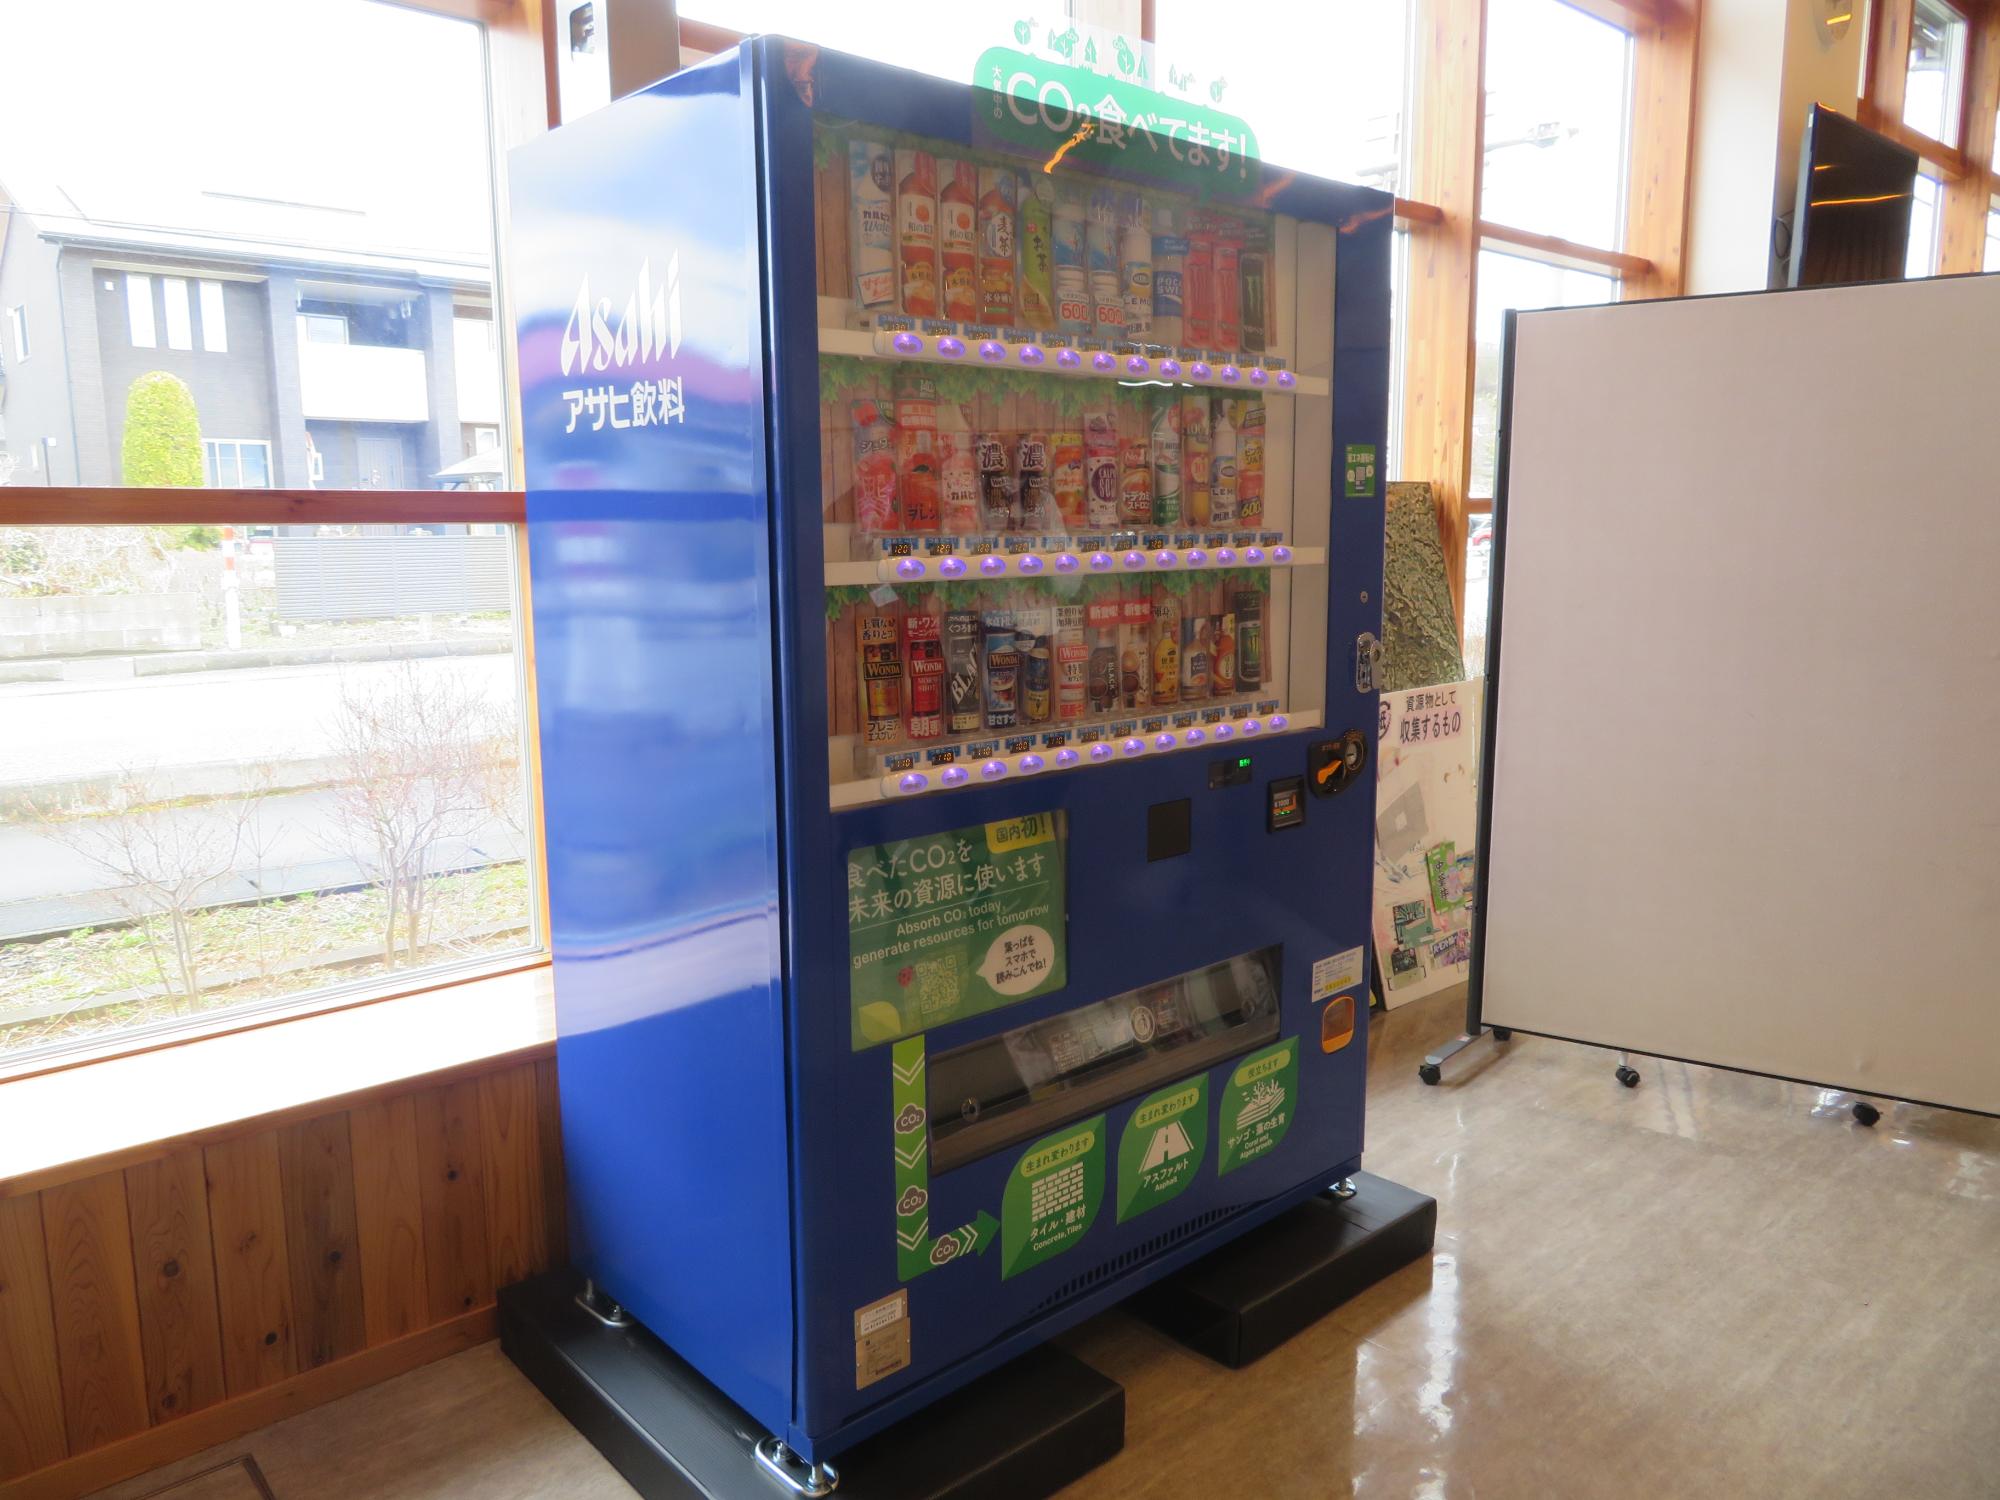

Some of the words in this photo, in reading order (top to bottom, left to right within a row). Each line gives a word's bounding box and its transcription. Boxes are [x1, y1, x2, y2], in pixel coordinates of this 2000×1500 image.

[561, 248, 682, 376] Asahi
[1062, 303, 1088, 320] 600
[1099, 308, 1124, 325] 600
[562, 376, 685, 434] アサヒ飲料
[867, 664, 900, 677] WONDA
[914, 660, 942, 673] WONDA
[993, 654, 1018, 666] WONDA
[1407, 690, 1456, 712] 資源物として
[1400, 711, 1461, 744] 収集するもの
[996, 813, 1046, 842] 国内初!
[849, 853, 1046, 923] 未来の資源に使います
[853, 940, 910, 969] generate
[912, 924, 975, 948] resources
[977, 917, 994, 932] for
[996, 904, 1049, 925] tomorrow
[896, 914, 940, 936] Absorb
[1005, 950, 1036, 968] スマホで
[1138, 1093, 1196, 1124] 生まれ変わります
[1025, 1136, 1090, 1172] 生まれ変わります
[1143, 1159, 1189, 1189] アスファルト
